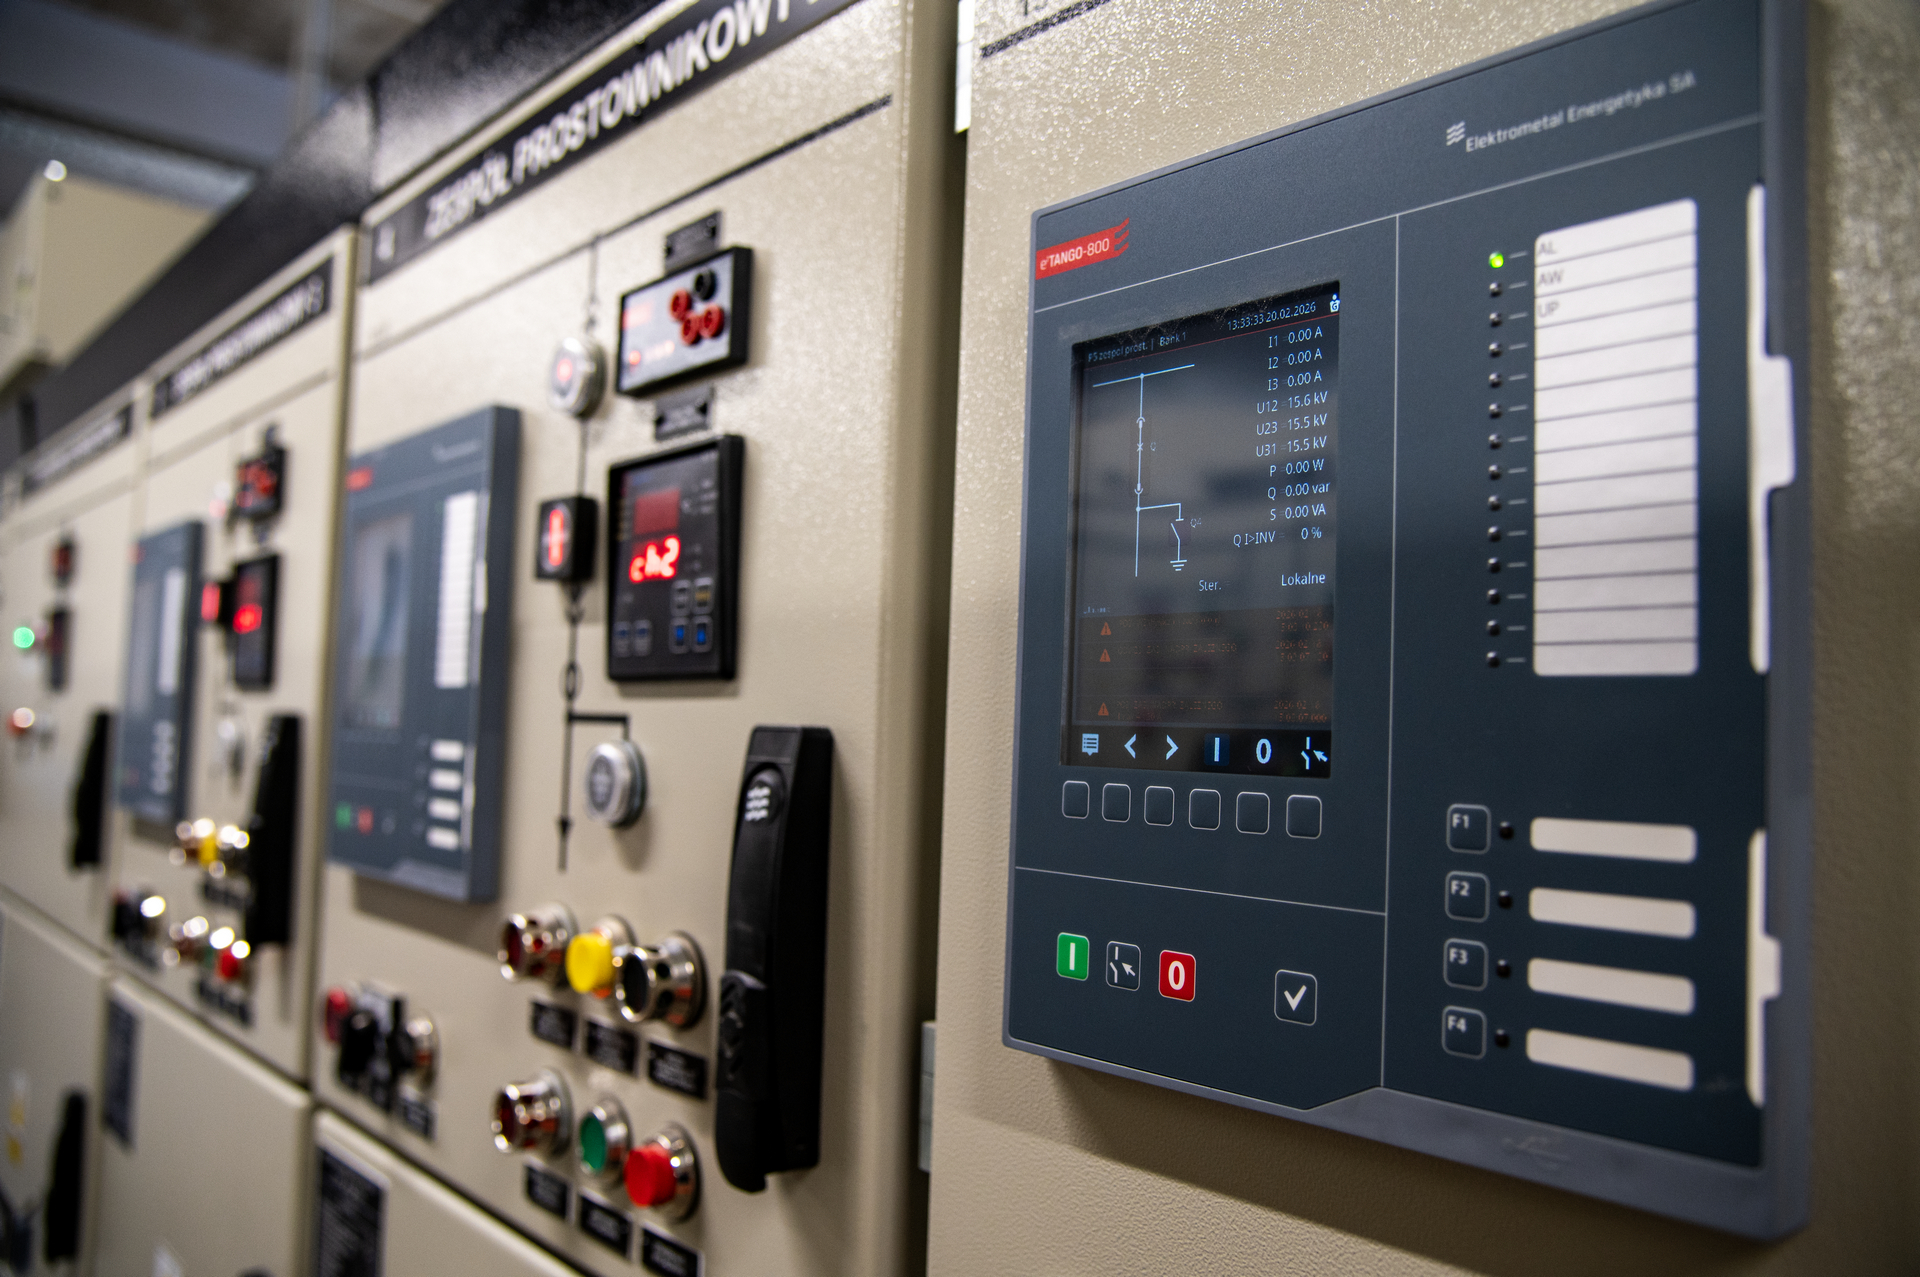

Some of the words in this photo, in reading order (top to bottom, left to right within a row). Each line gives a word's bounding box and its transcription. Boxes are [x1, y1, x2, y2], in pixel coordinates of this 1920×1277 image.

[1466, 110, 1564, 153] Elektrometal
[1566, 81, 1667, 123] Energetyka
[1668, 69, 1696, 95] SA
[1538, 240, 1557, 256] AL
[1538, 269, 1564, 287] AW
[1227, 313, 1264, 331] 13:33:33
[1265, 301, 1316, 323] 20.02.2026
[1537, 301, 1559, 319] UP
[1160, 333, 1180, 346] Bank
[1268, 335, 1278, 348] I1
[1288, 328, 1312, 343] 0.00
[1314, 326, 1323, 339] A
[1268, 357, 1279, 370] I2
[1287, 350, 1312, 366] 0.00
[1313, 348, 1322, 360] A
[1268, 379, 1279, 391] I3
[1287, 372, 1312, 387] 0.00
[1313, 370, 1322, 382] A
[1256, 399, 1278, 415] U12
[1288, 394, 1311, 409] 15.6
[1313, 390, 1328, 404] kV
[1256, 421, 1278, 436] U23
[1287, 416, 1311, 431] 15.5
[1313, 413, 1328, 426] kV
[1256, 443, 1277, 458] U31
[1287, 438, 1310, 453] 15.5
[1313, 435, 1327, 449] kV
[1269, 465, 1276, 477] P
[1285, 461, 1310, 476] 0.00
[1311, 458, 1325, 472] W
[1267, 486, 1276, 500] Q
[1285, 483, 1309, 497] 0.00
[1312, 481, 1331, 494] var
[1270, 508, 1276, 521] S
[1285, 505, 1309, 519] 0.00
[1311, 503, 1326, 516] VA
[1233, 534, 1242, 548] Q
[1301, 528, 1308, 540] 0
[1311, 526, 1322, 539] %
[1198, 578, 1222, 592] Ster.
[1281, 571, 1326, 587] Lokalne
[1452, 813, 1470, 829] F1
[1450, 880, 1470, 897] F2
[1449, 947, 1468, 965] F3
[1447, 1015, 1467, 1033] F4
